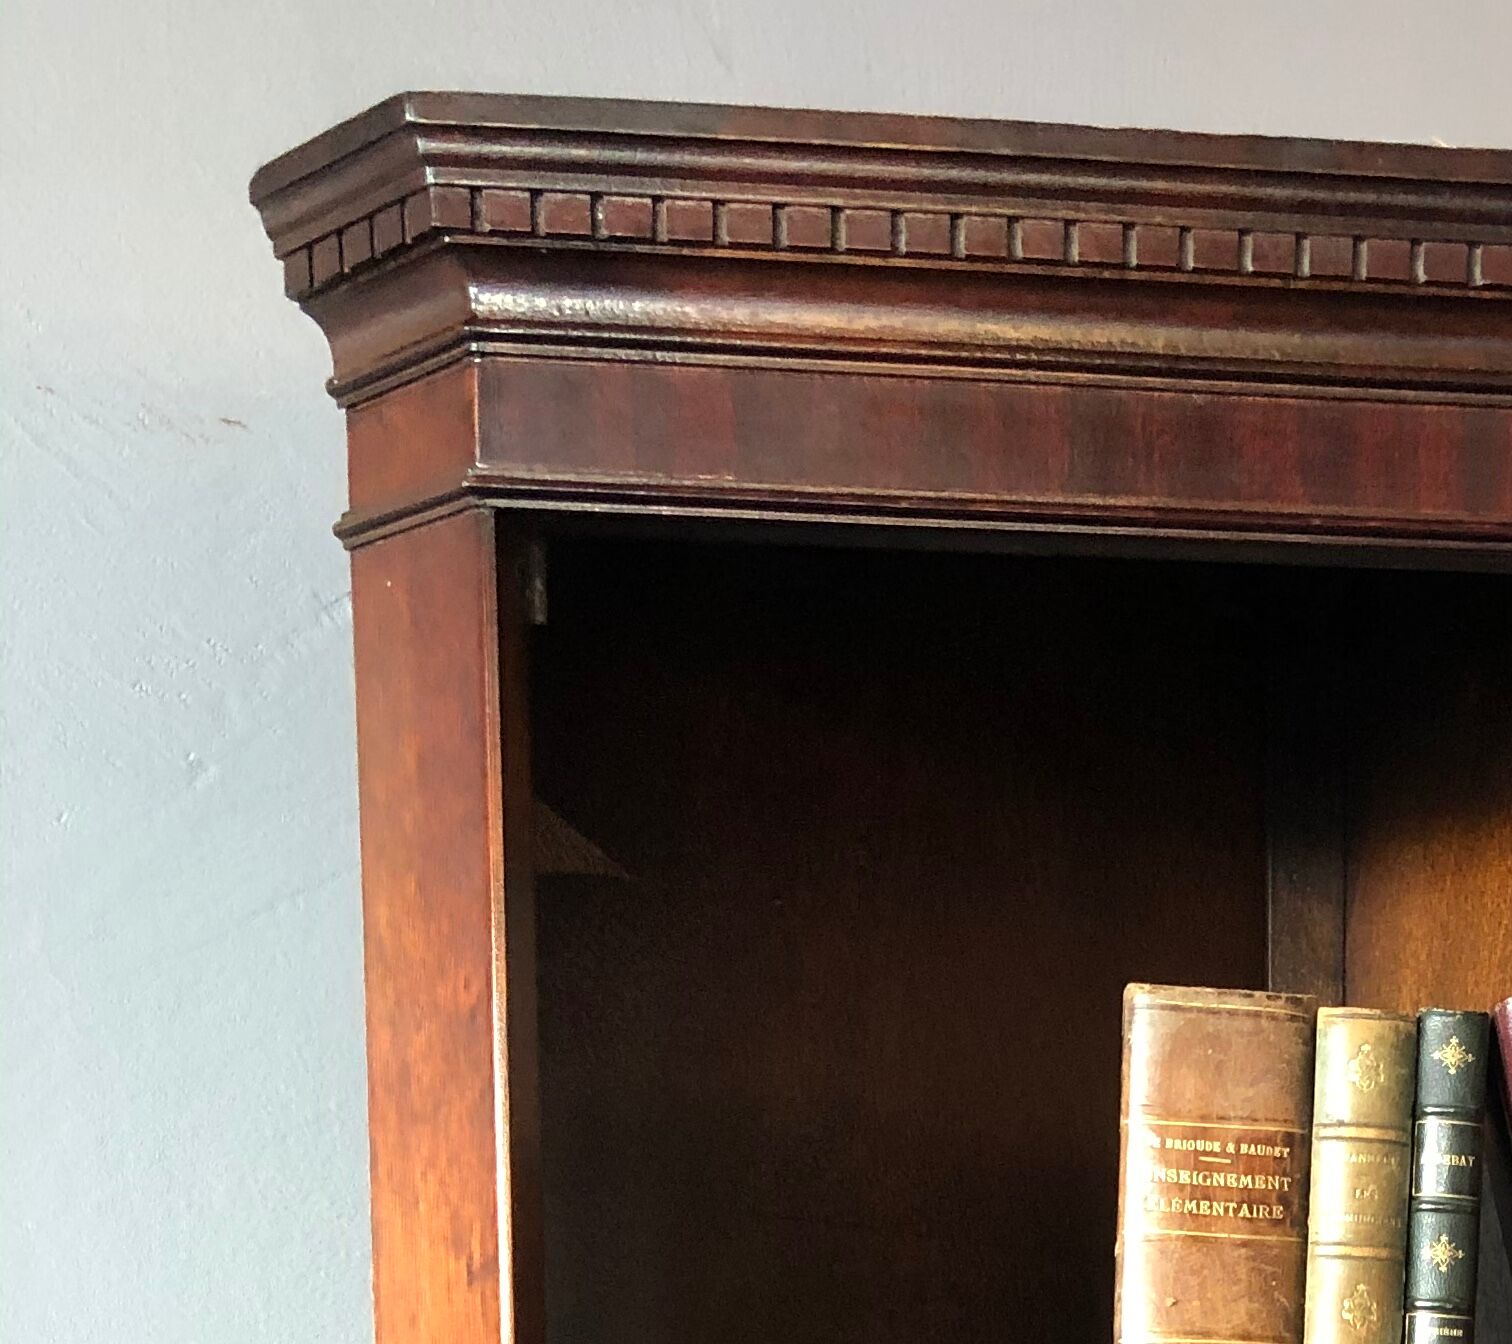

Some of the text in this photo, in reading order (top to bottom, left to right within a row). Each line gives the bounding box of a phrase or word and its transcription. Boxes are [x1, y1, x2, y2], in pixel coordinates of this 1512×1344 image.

[1165, 1138, 1221, 1153] BRIOUDE
[1226, 1144, 1236, 1154] &
[1240, 1143, 1291, 1158] BAUDET
[1141, 1167, 1292, 1192] NSEIGNEMENT
